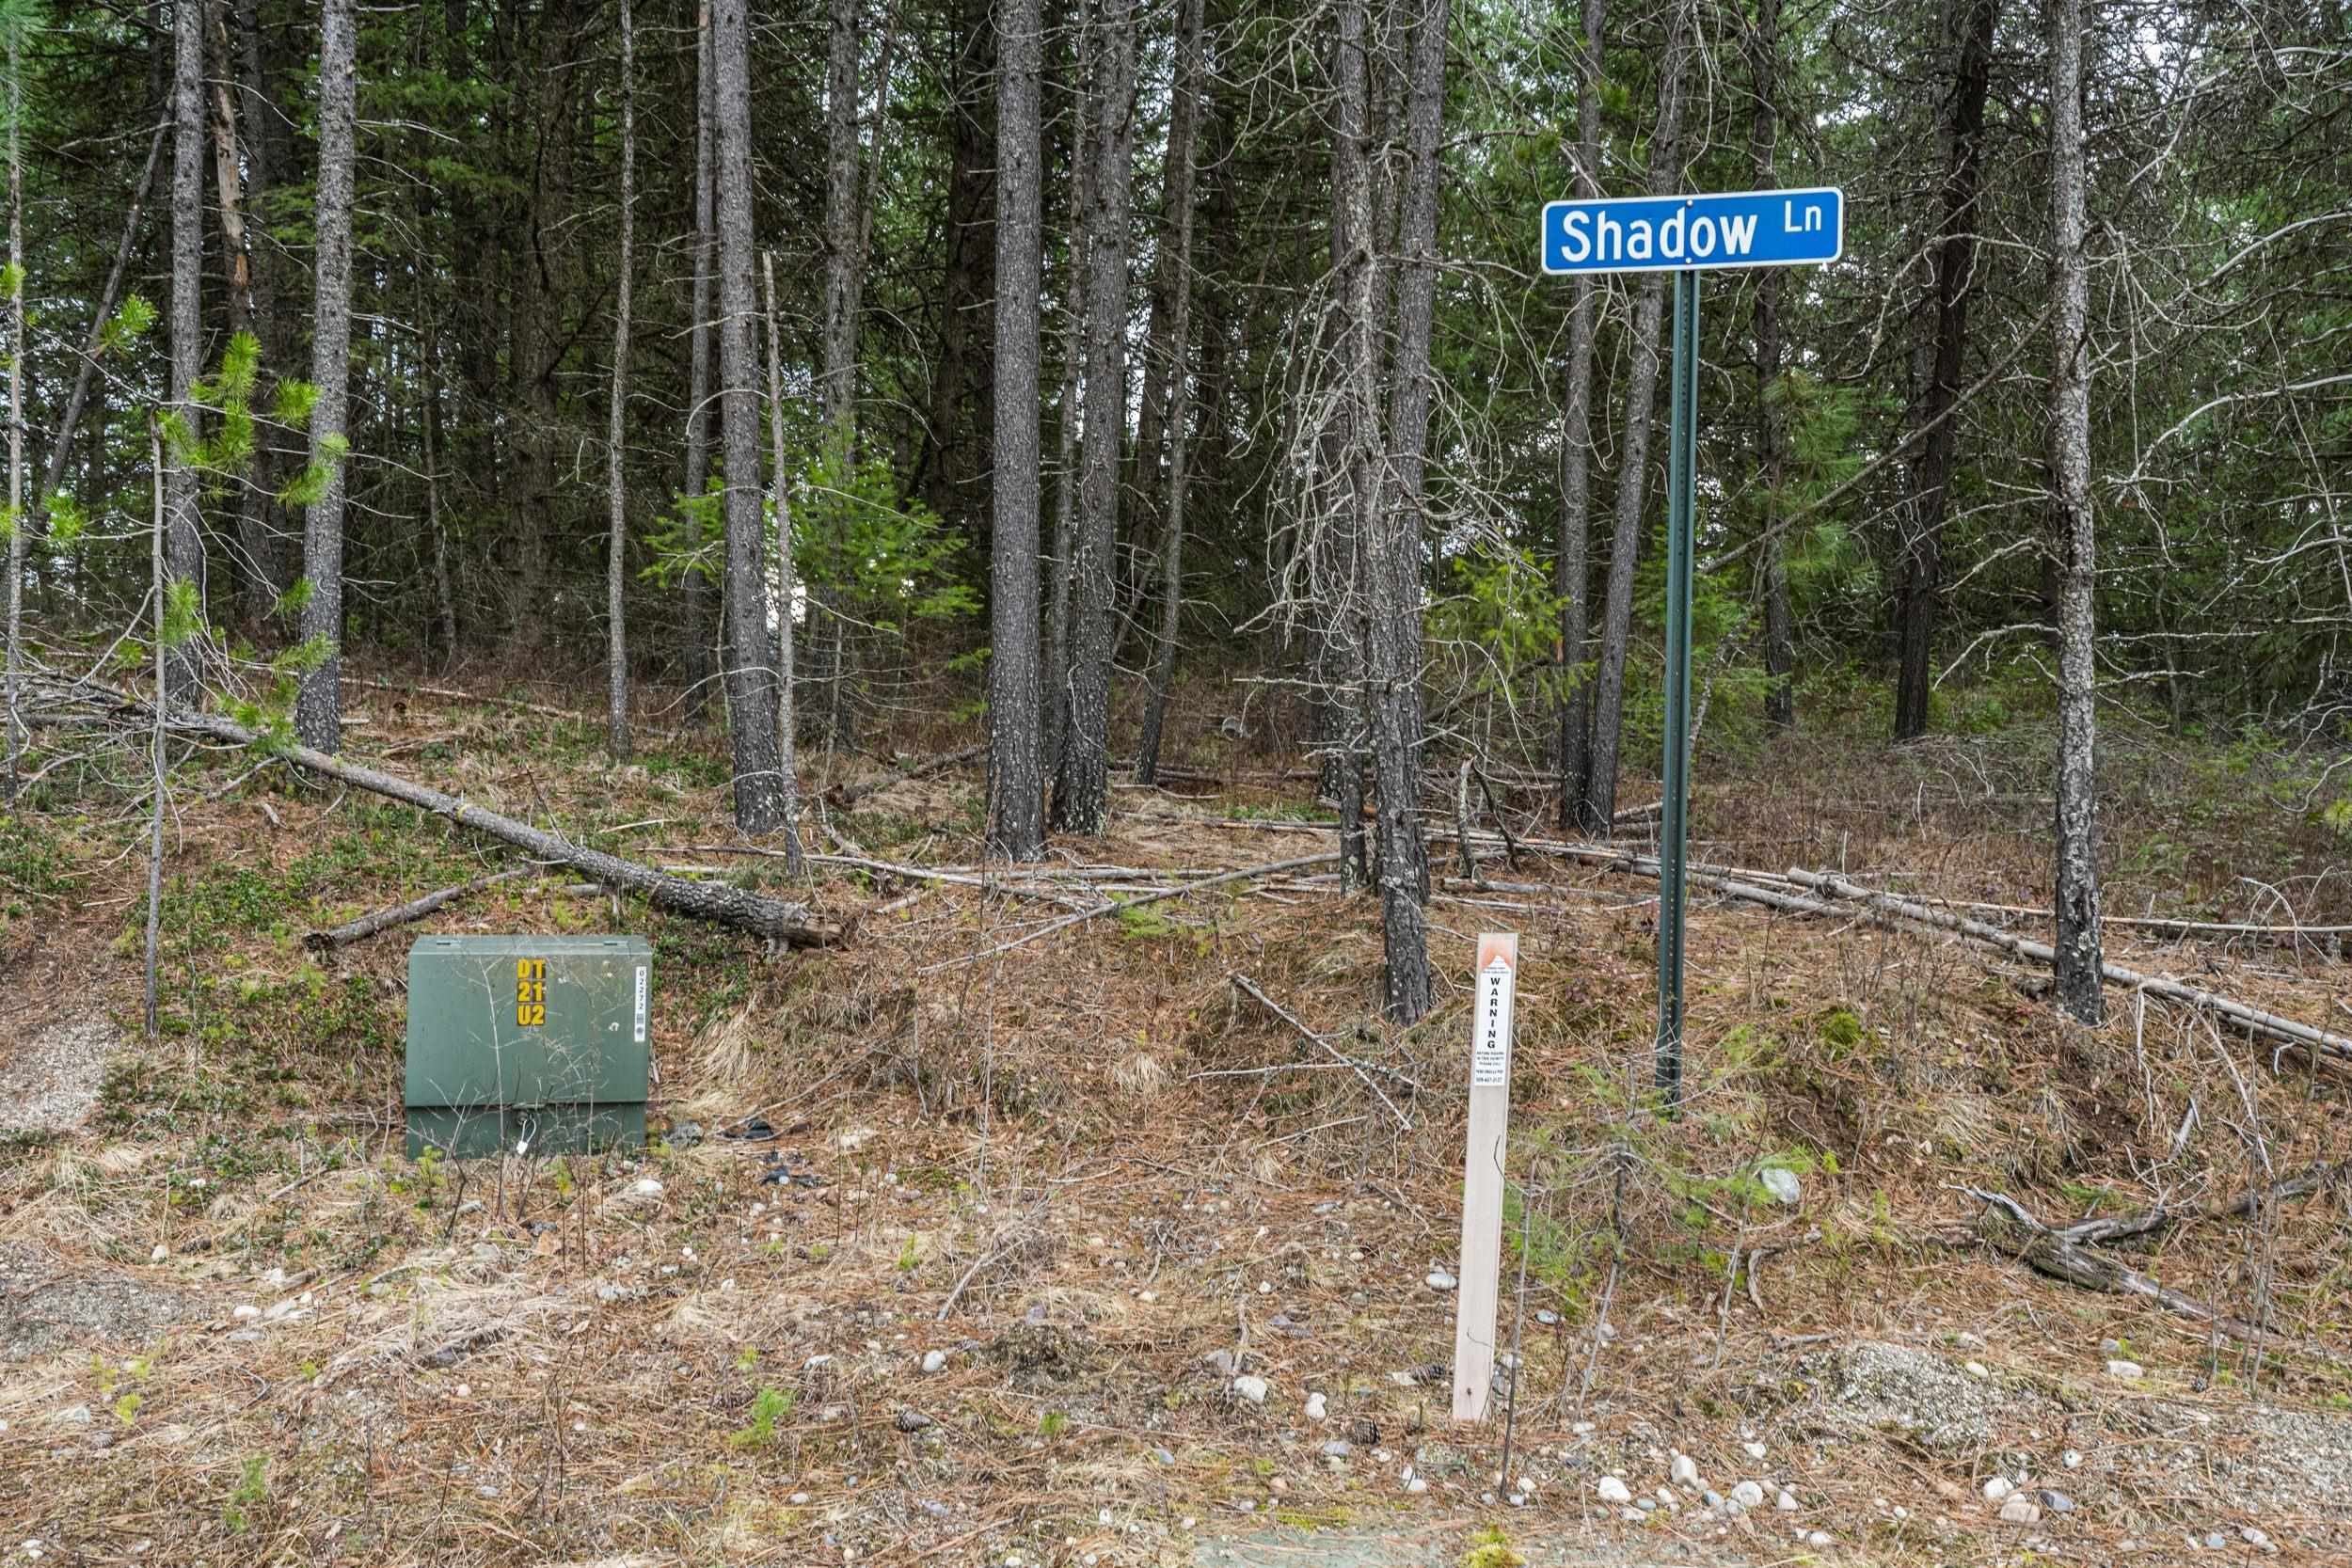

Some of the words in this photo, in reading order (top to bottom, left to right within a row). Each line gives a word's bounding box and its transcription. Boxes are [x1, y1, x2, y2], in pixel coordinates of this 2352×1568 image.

[1560, 206, 1758, 262] Shadow
[1784, 199, 1822, 233] Ln
[517, 980, 543, 1002] 21
[517, 1005, 545, 1025] U2
[1486, 977, 1501, 1049] WARNING
